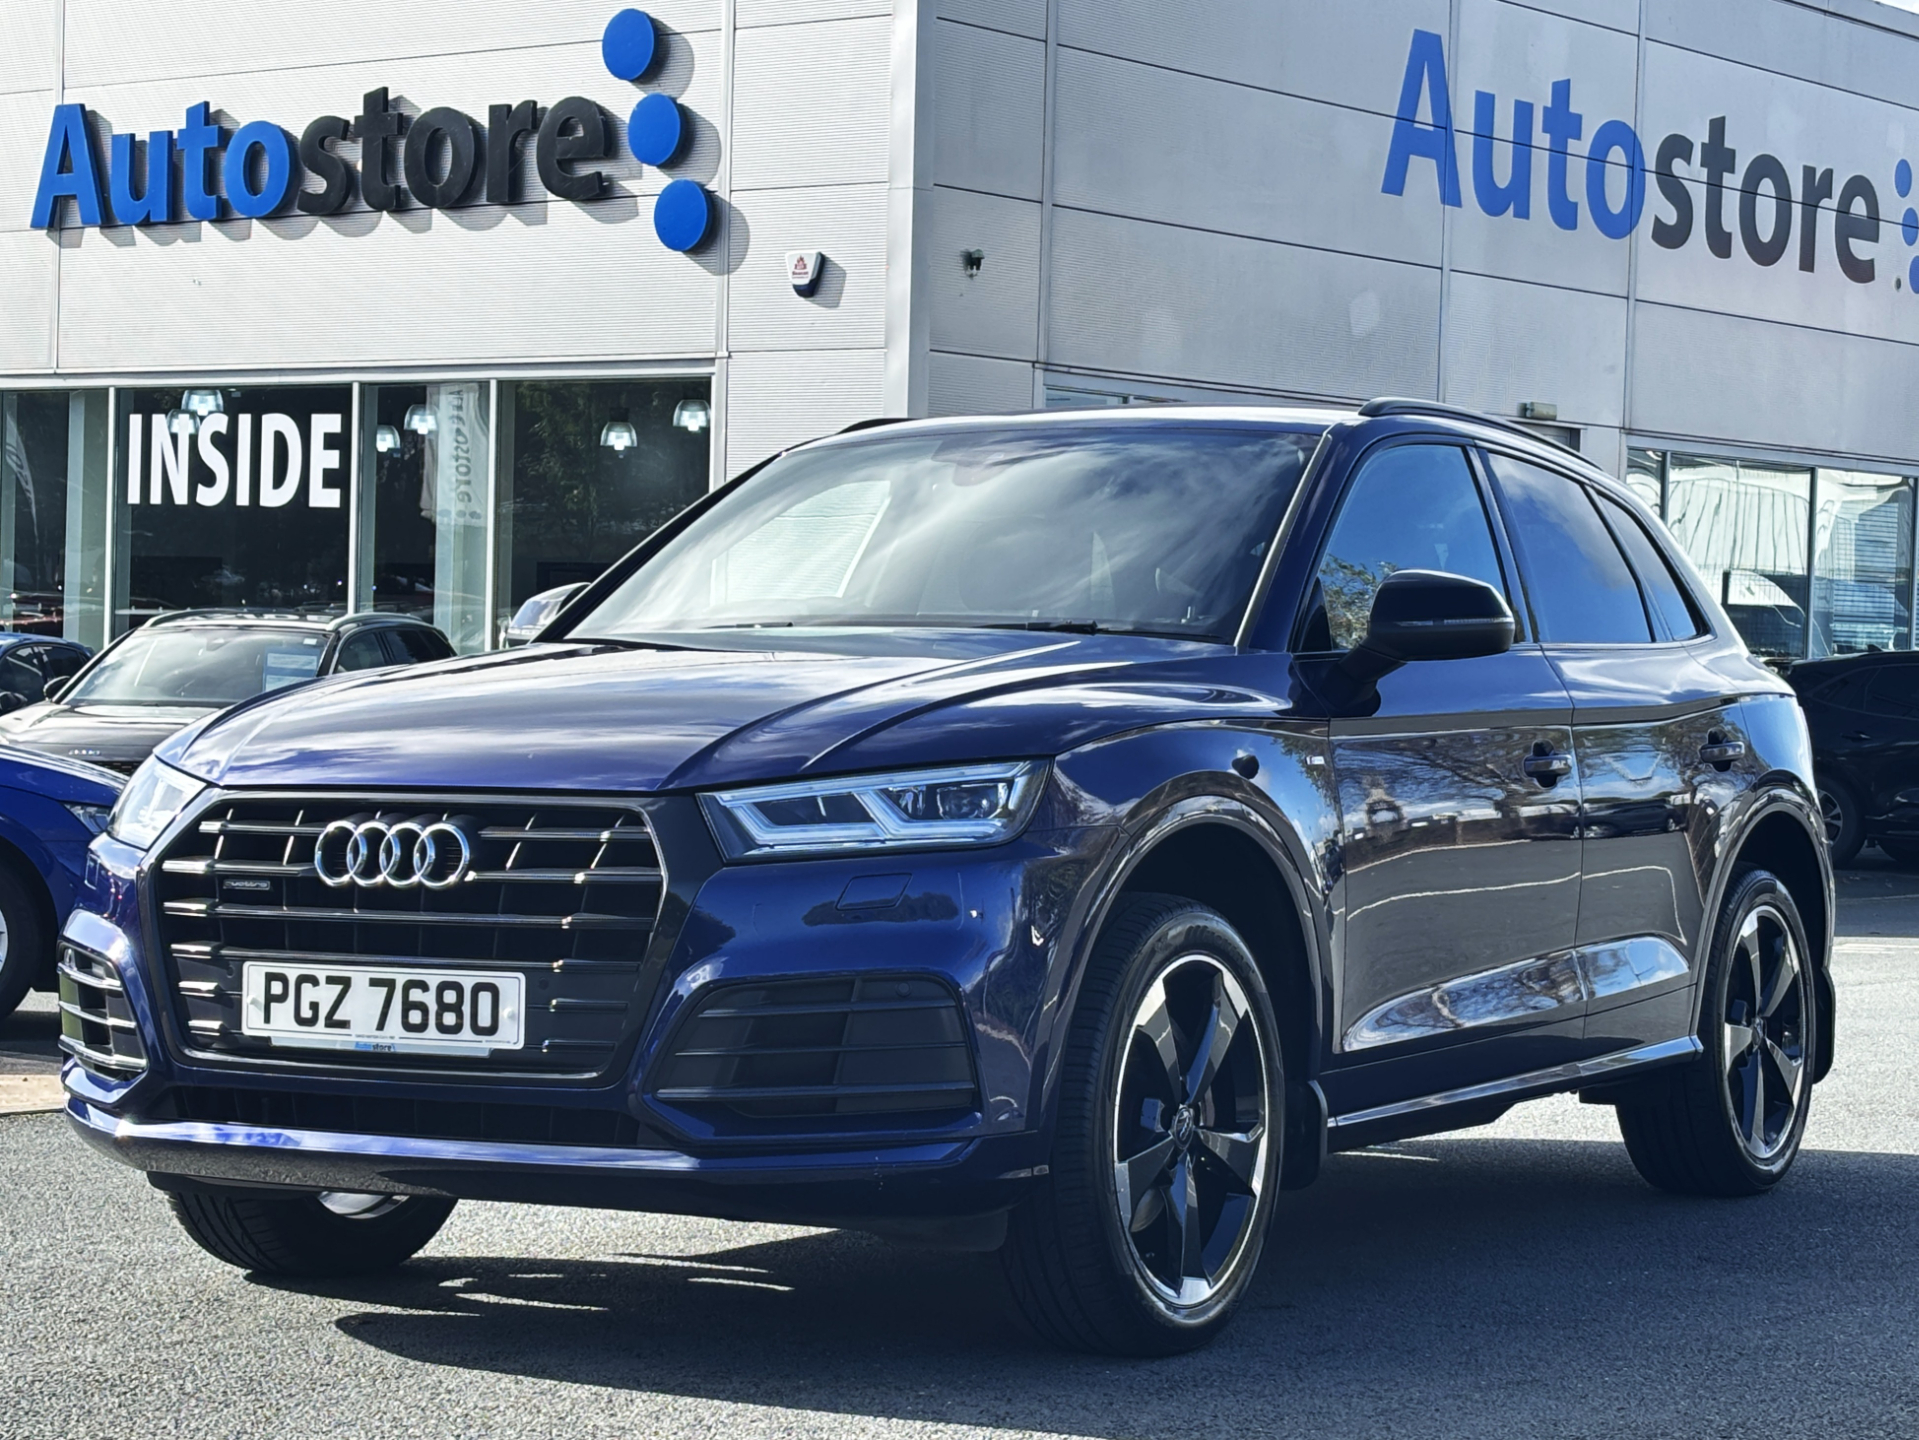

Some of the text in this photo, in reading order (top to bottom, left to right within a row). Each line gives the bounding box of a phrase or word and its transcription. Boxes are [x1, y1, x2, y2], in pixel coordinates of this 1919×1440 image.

[31, 87, 609, 229] Autostore
[1381, 28, 1880, 284] Autostore
[127, 412, 342, 508] INSIDE
[263, 971, 500, 1036] PGZ 7680
[354, 1041, 393, 1052] store
